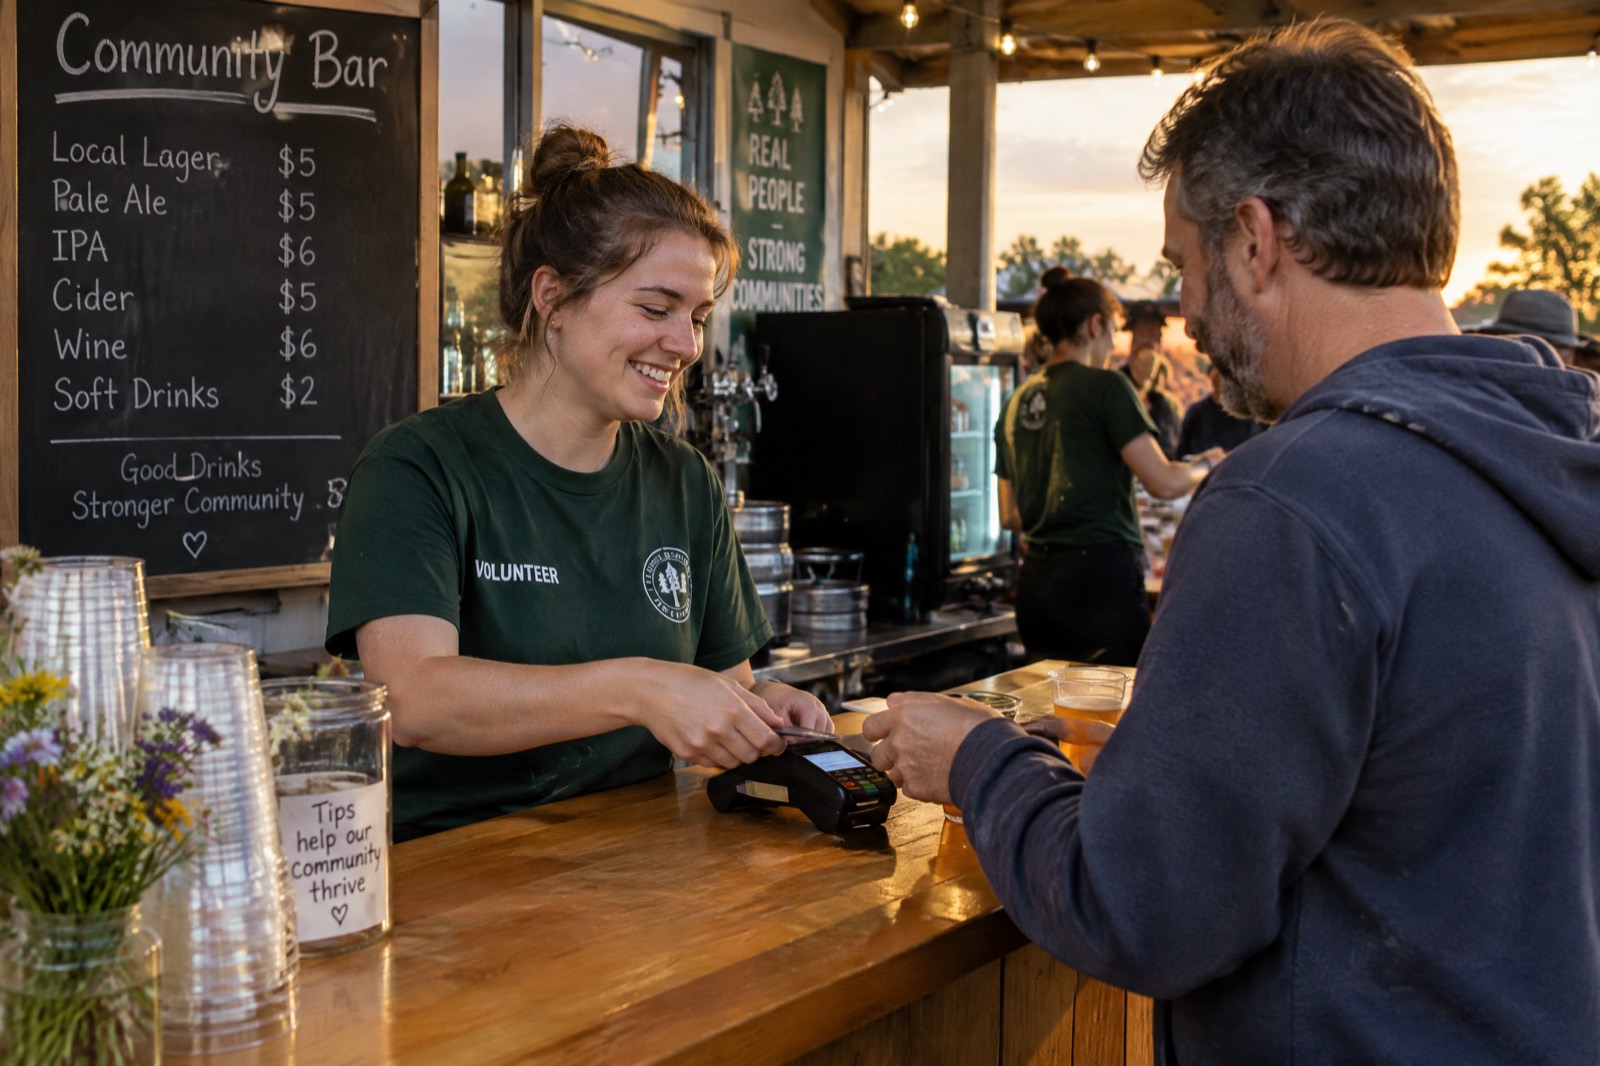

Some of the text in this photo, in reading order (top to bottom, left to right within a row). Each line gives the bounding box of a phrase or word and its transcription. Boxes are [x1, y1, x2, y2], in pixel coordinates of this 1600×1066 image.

[56, 12, 388, 113] Community Bar
[53, 131, 316, 183] Local Lager $5
[749, 133, 791, 170] REAL
[52, 179, 316, 223] Pale Ale $5
[749, 175, 805, 213] PEOPLE
[52, 229, 316, 268] IPA $6
[748, 237, 805, 273] STRONG
[52, 277, 316, 315] Cider $5
[731, 278, 824, 313] COMMUNITIES
[54, 325, 317, 362] Wine $6
[54, 372, 317, 412] Soft Drinks $2
[121, 451, 262, 483] Good Drinks
[72, 490, 175, 529] Stronger
[185, 483, 304, 522] Community
[475, 559, 560, 584] VOLUNTEER
[312, 800, 355, 829] Tips
[296, 825, 373, 856] help our
[308, 875, 366, 903] thrive
